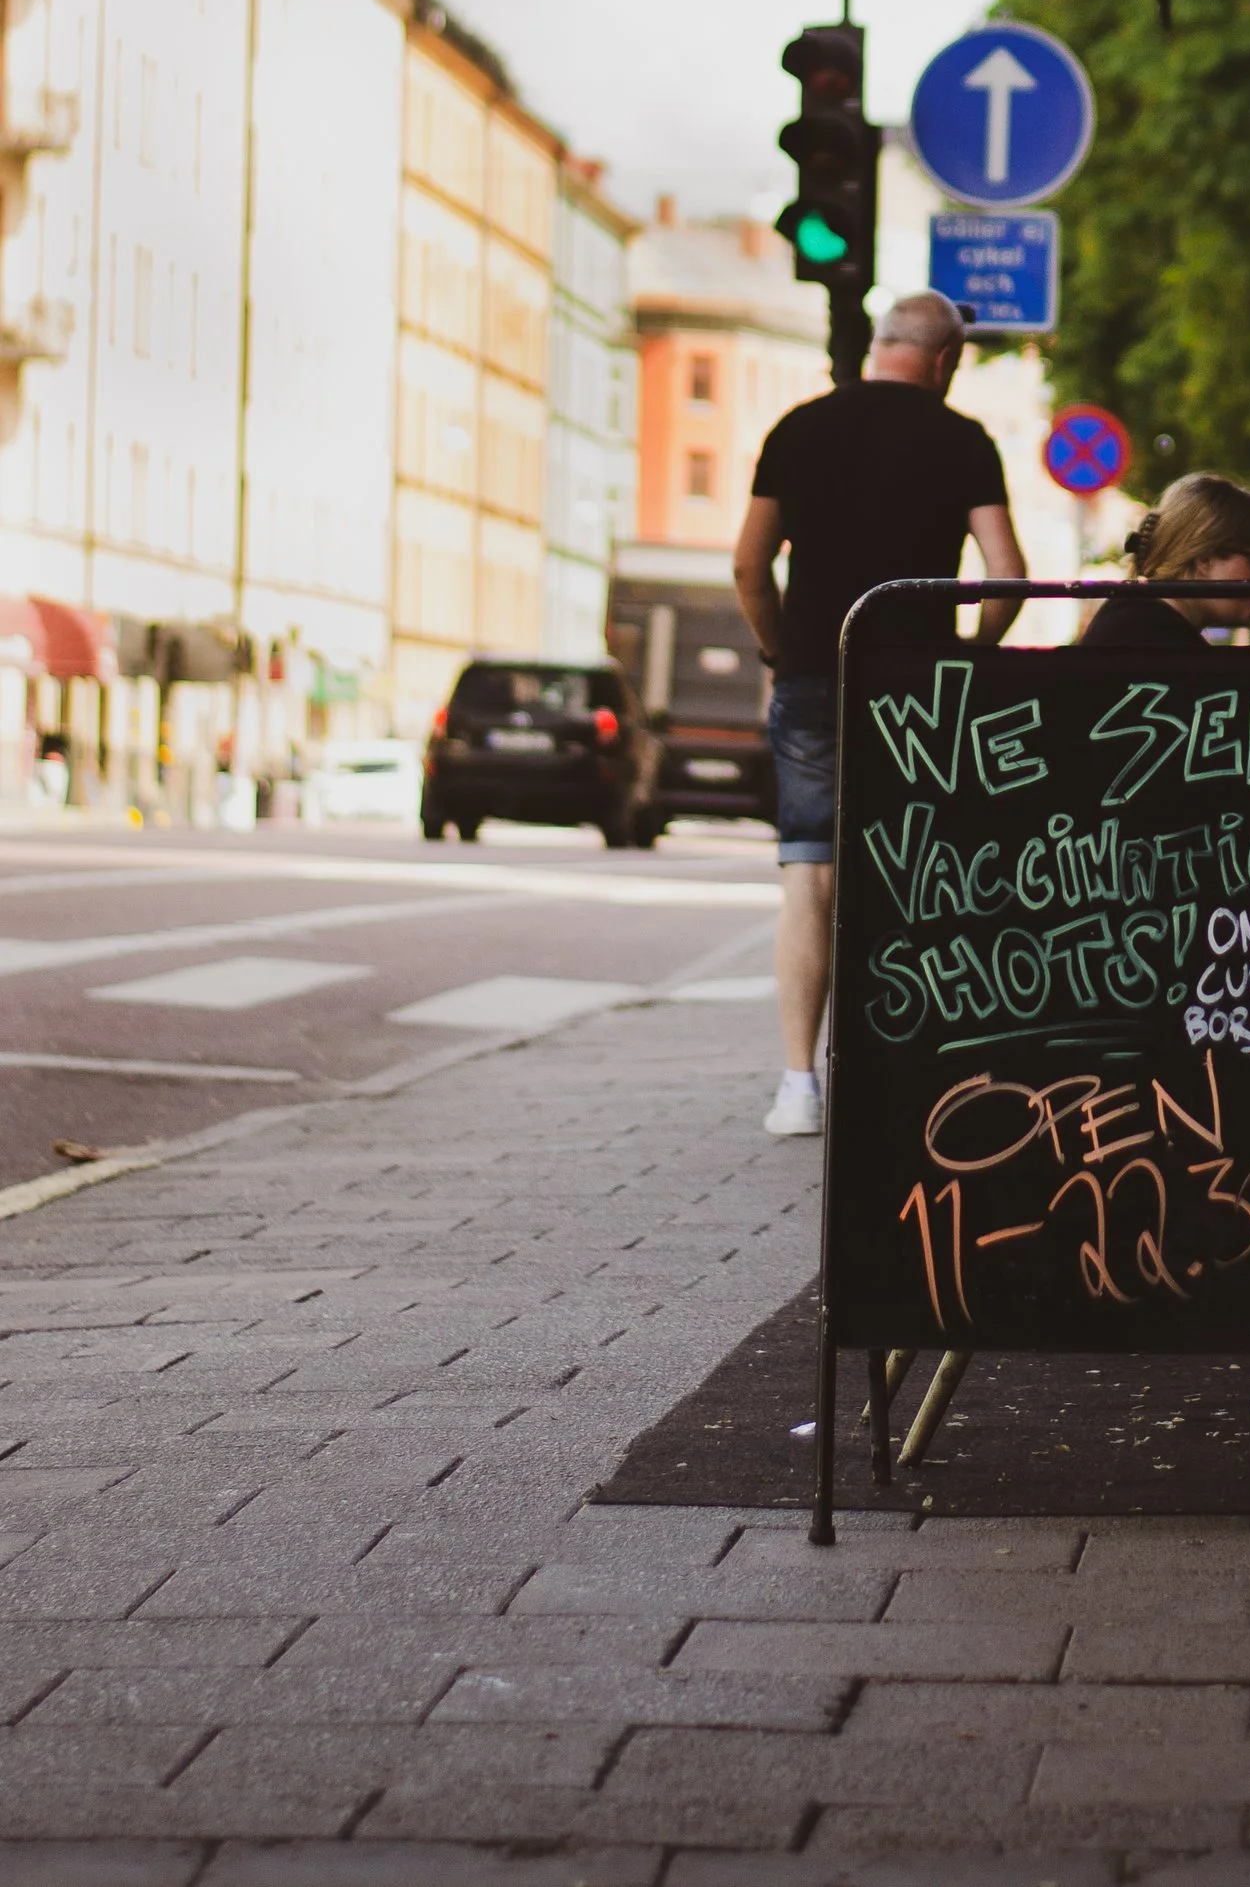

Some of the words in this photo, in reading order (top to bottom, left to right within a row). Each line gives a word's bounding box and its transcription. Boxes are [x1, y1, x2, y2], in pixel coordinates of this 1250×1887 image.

[868, 660, 1049, 796] WE
[865, 902, 1198, 1043] SHOTS!
[925, 1048, 1225, 1173] OPEN
